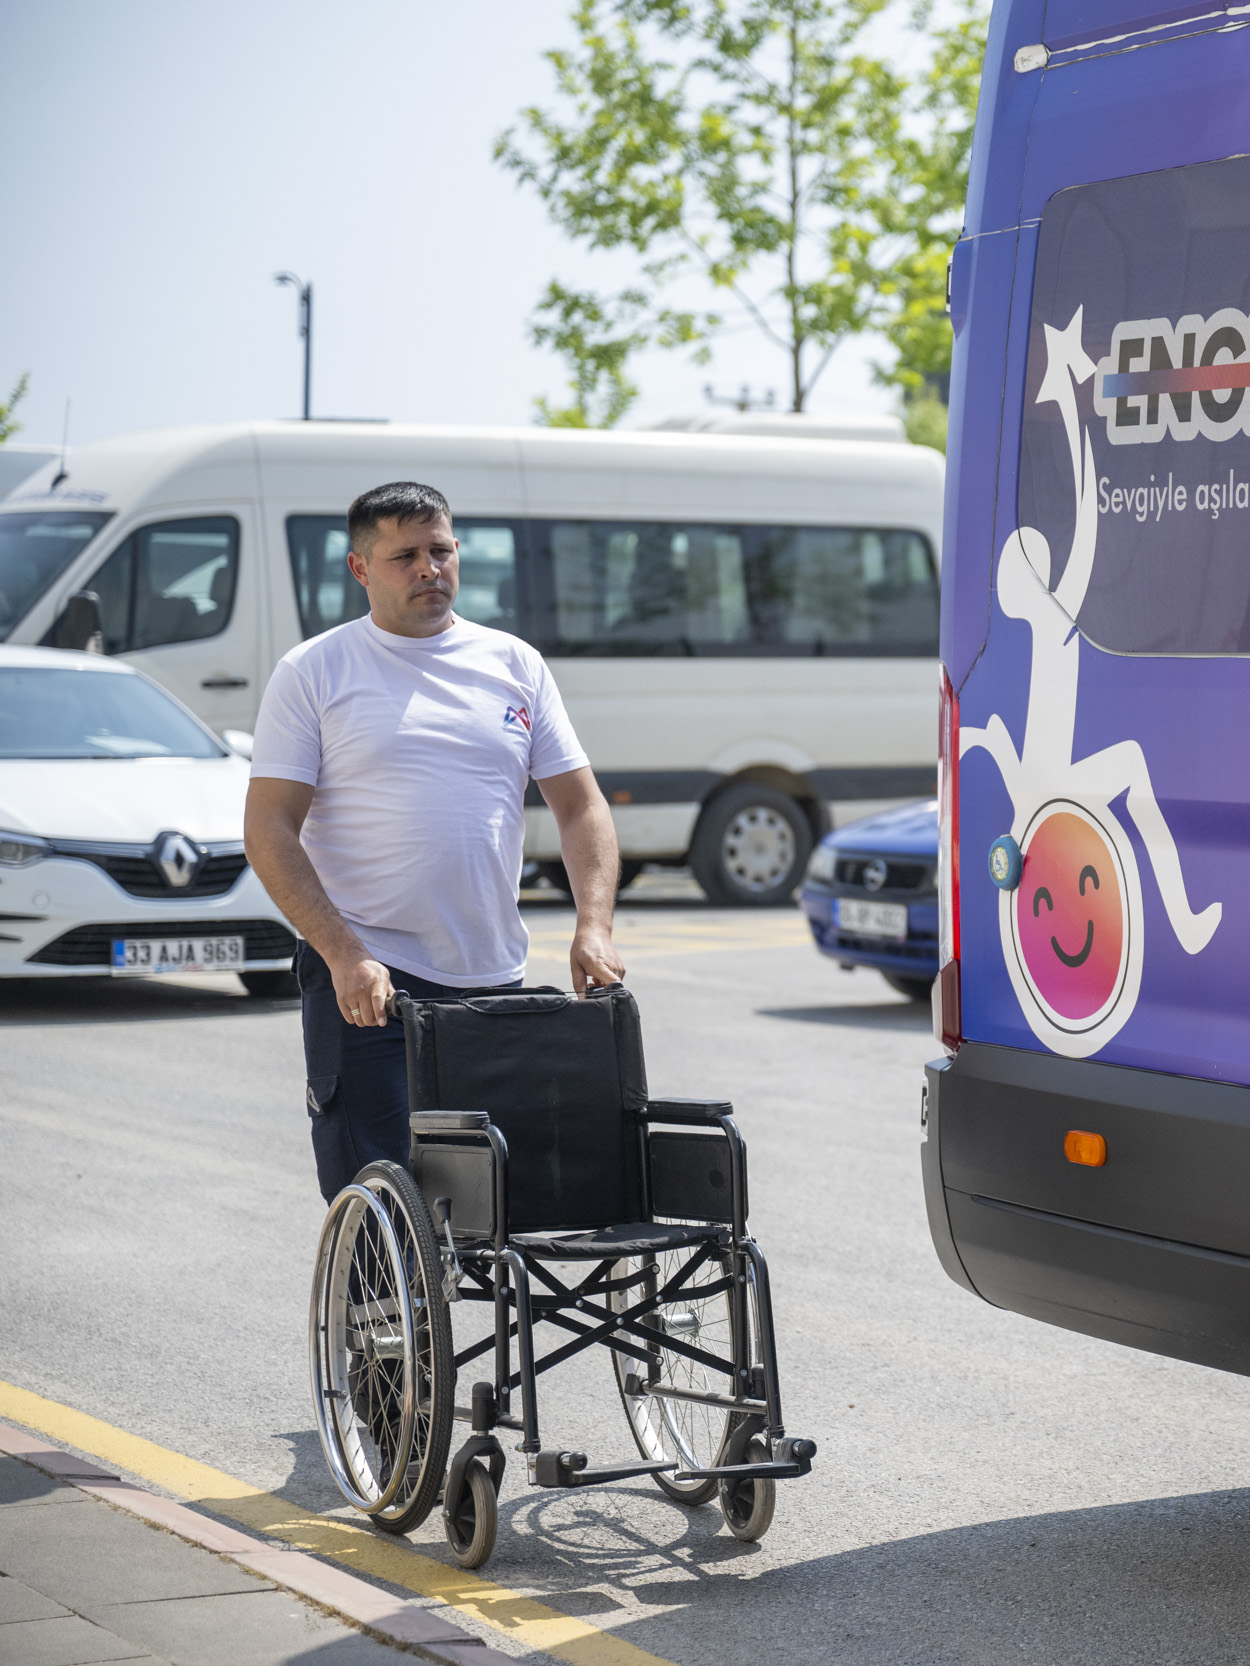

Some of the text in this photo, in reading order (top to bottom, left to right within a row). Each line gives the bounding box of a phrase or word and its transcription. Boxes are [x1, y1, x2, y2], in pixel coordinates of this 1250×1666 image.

[1097, 472, 1189, 524] Sevgiyle
[126, 938, 241, 965] 33 AJA 969
